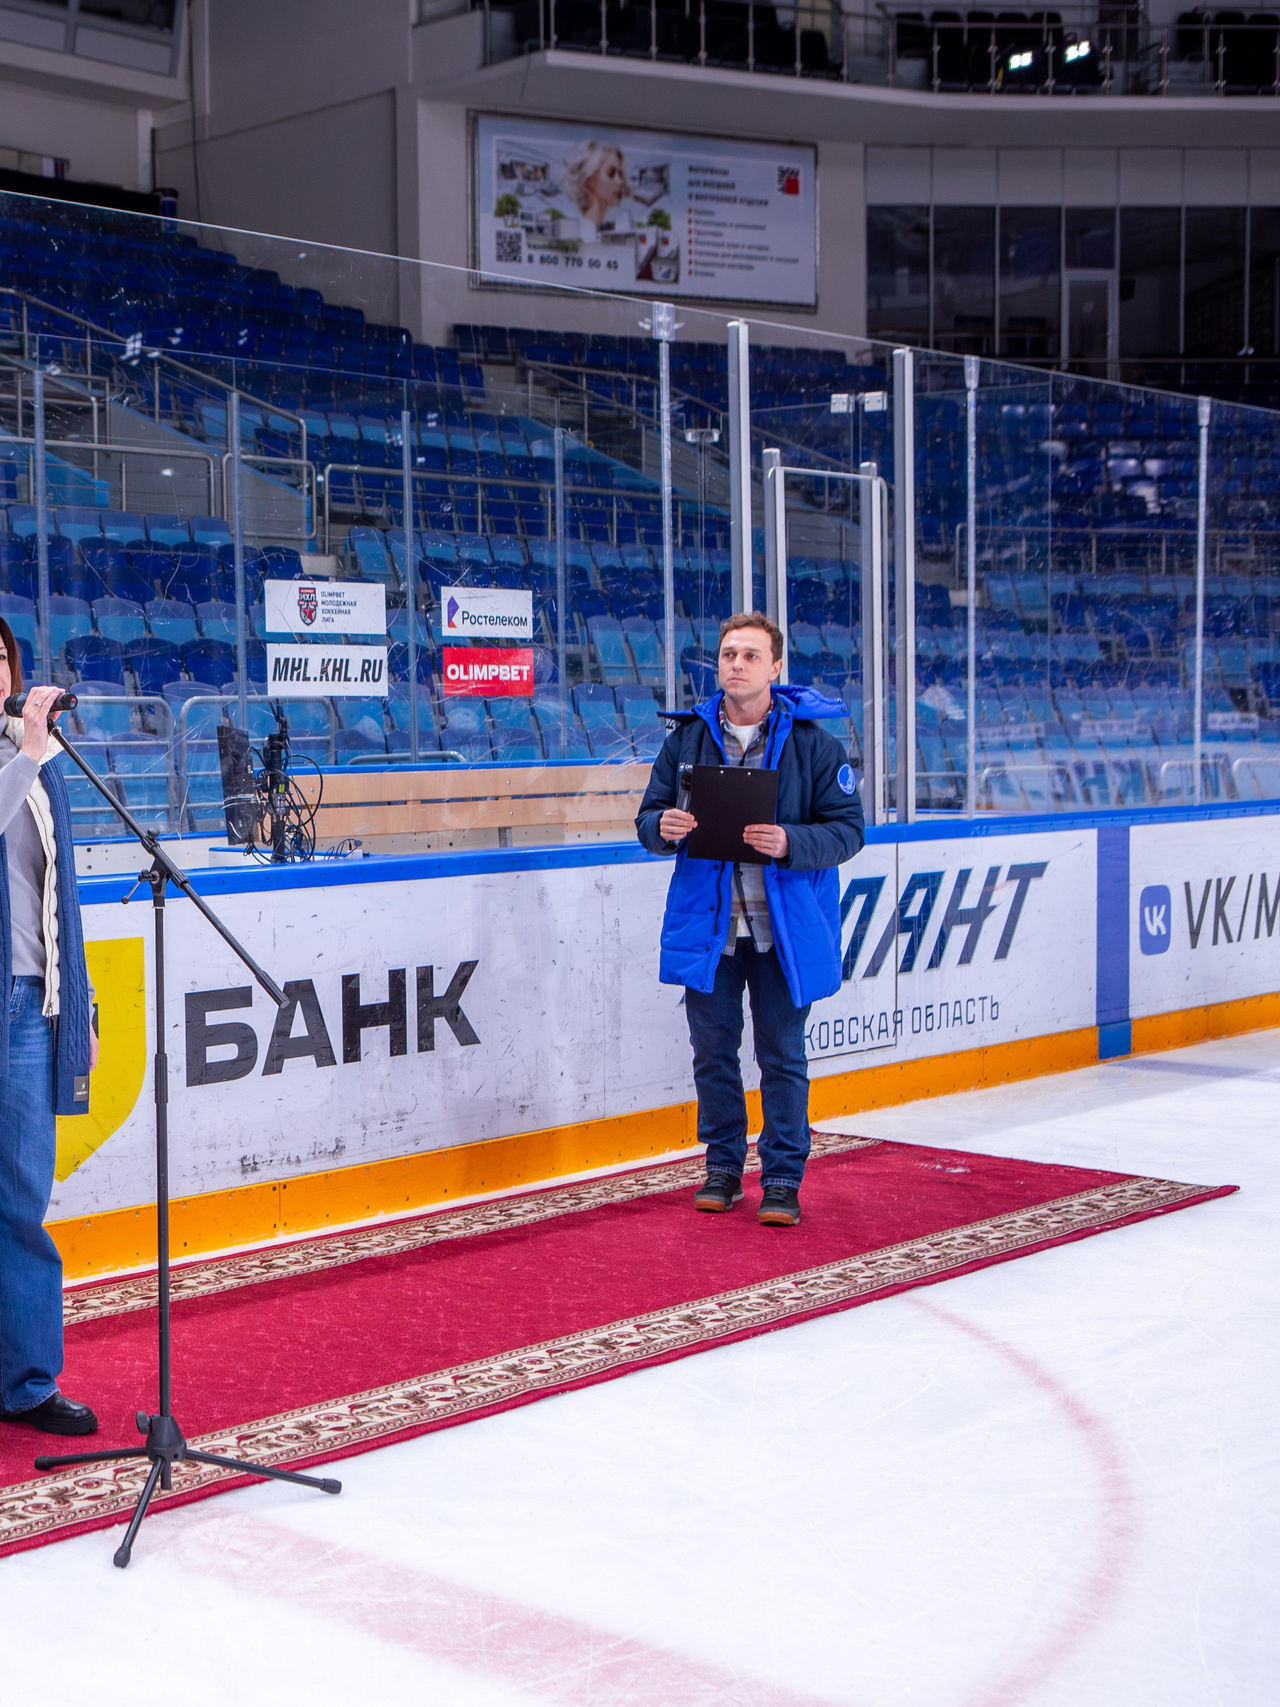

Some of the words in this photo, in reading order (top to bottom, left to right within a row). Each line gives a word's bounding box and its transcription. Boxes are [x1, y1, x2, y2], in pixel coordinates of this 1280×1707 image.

[564, 256, 583, 267] 770
[321, 607, 351, 615] ХОККЕЙНАЯ
[461, 610, 528, 628] Ростелеком
[272, 657, 384, 683] MHL.KHL.RU
[446, 664, 531, 682] OLIMPBET
[184, 959, 481, 1087] БАНК
[912, 995, 1000, 1034] ОБЛАСТЬ
